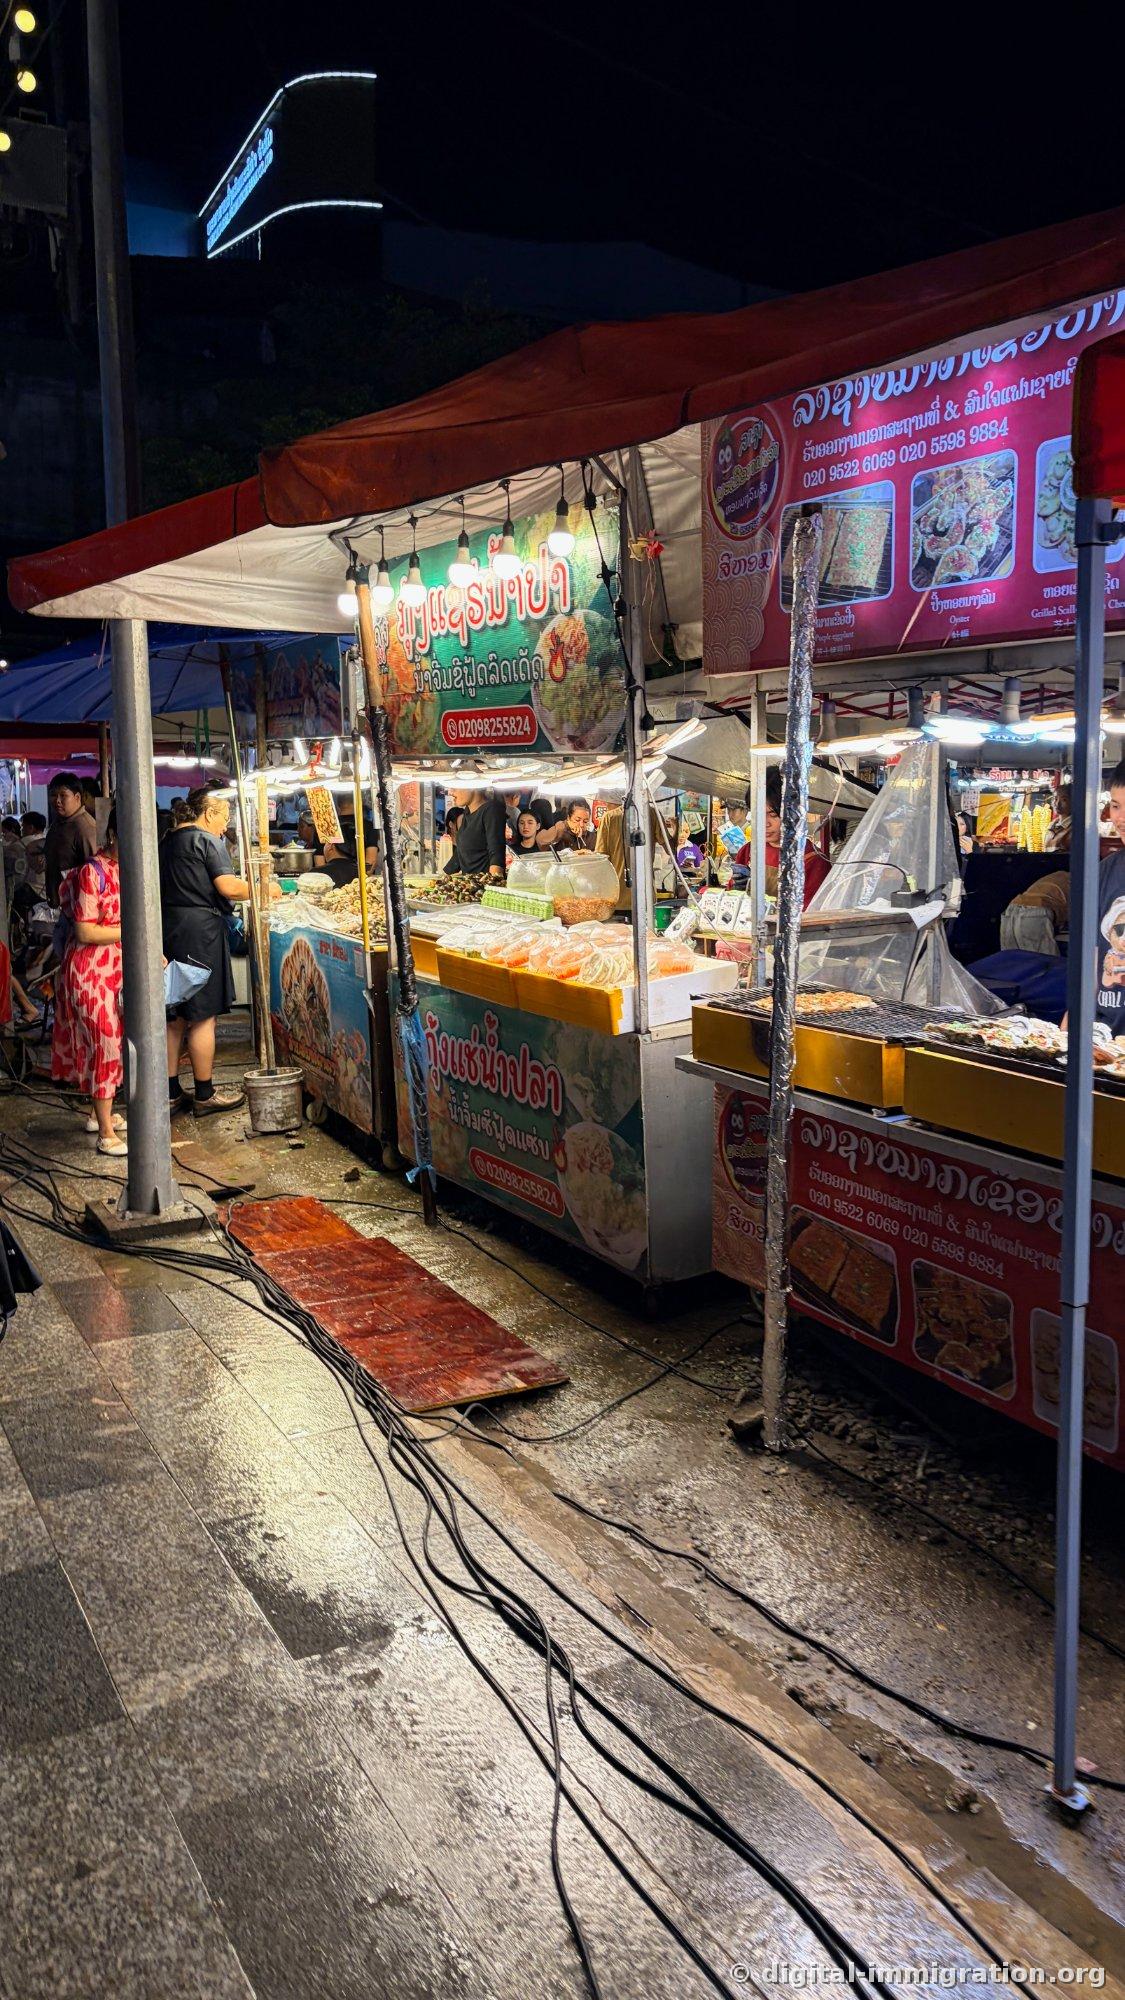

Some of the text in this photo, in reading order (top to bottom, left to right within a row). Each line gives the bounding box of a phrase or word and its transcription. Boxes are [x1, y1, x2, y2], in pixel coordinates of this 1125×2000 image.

[944, 401, 961, 420] &
[803, 417, 1009, 488] 020 9522 6069 020 5598 9884
[459, 714, 531, 738] 02098255824
[486, 1163, 558, 1209] 02098255824
[809, 1188, 1005, 1280] 020 9522 6069 020 5598 9884
[946, 1214, 960, 1233] &
